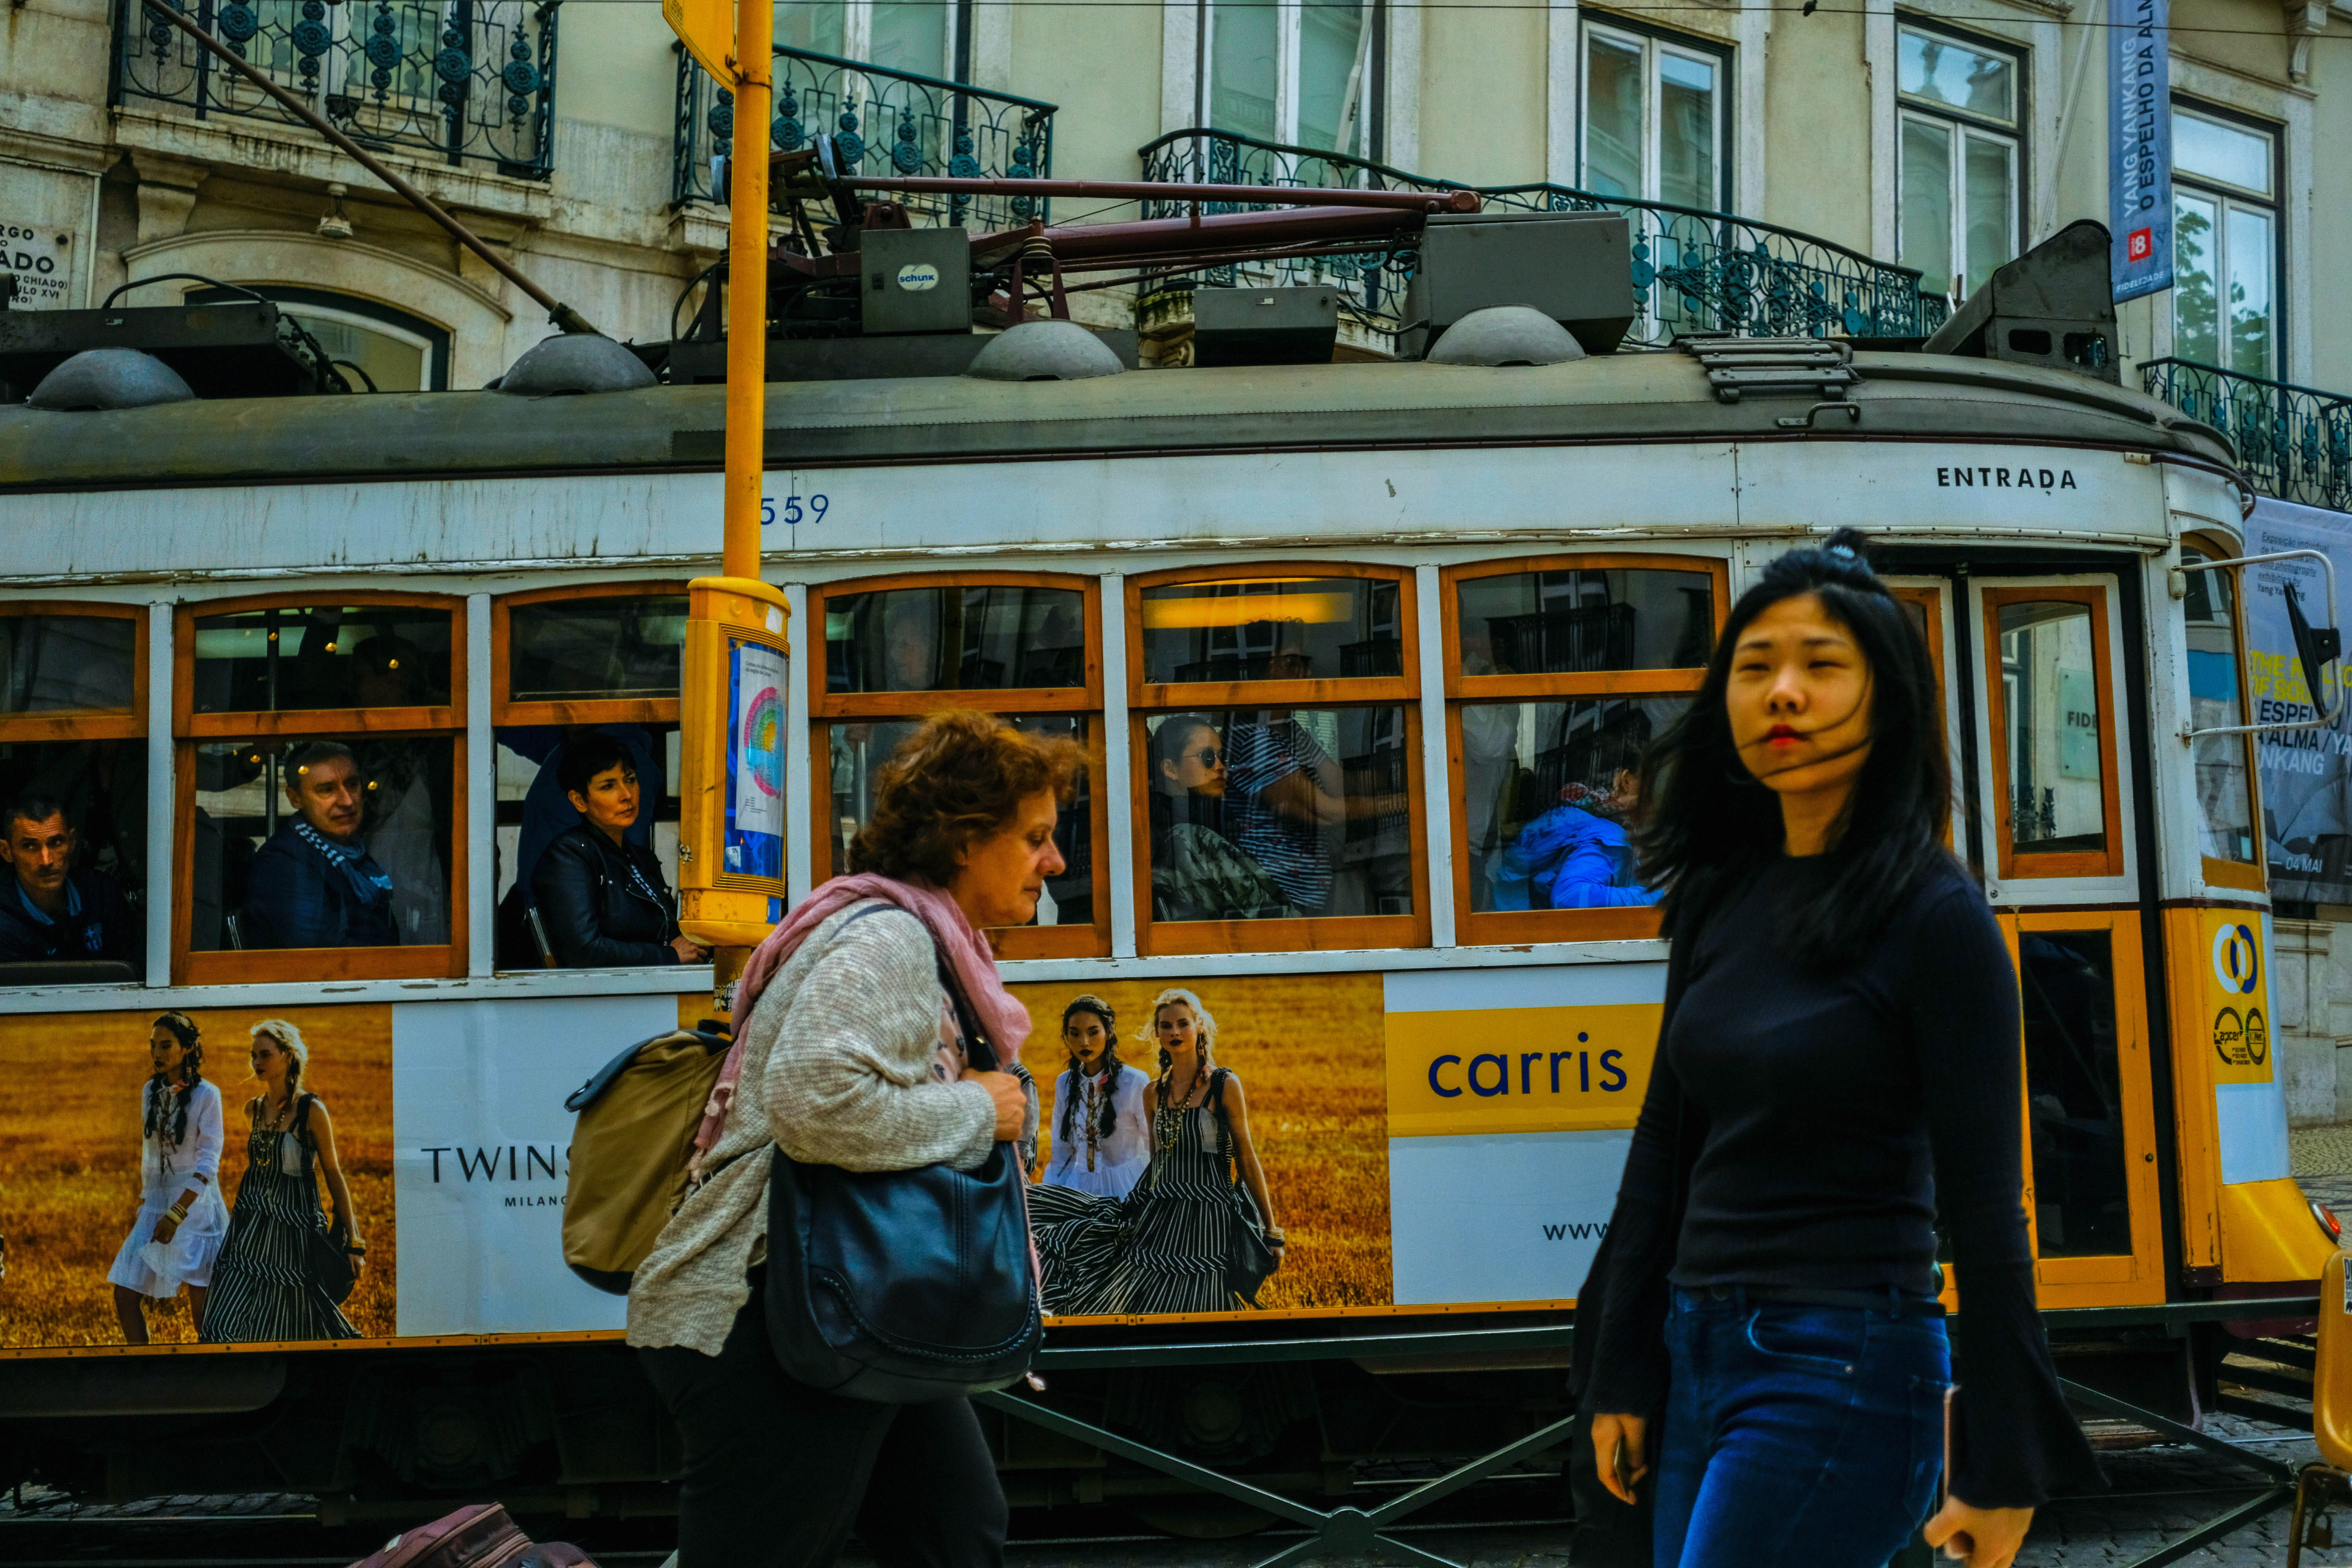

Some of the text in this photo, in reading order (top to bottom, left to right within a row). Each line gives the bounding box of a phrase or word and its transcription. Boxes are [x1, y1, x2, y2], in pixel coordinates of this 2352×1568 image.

[2138, 44, 2154, 77] DA
[2121, 37, 2138, 218] YANG YANKANG
[2138, 83, 2154, 189] ESPELHO
[2140, 195, 2154, 211] O
[2135, 235, 2146, 254] 8
[24, 276, 68, 290] CHIADO)
[2116, 271, 2164, 293] FIDELIDADE
[41, 289, 59, 299] XVI
[1937, 467, 2077, 489] ENTRADA
[760, 494, 829, 526] 559
[2262, 532, 2296, 546] Exposição
[2275, 562, 2317, 576] photography
[2257, 583, 2273, 596] Yang
[2251, 650, 2286, 677] THE
[2274, 678, 2311, 704] SOU
[2286, 857, 2300, 872] 04
[2302, 858, 2323, 873] MAI
[1428, 1031, 1627, 1098] carris
